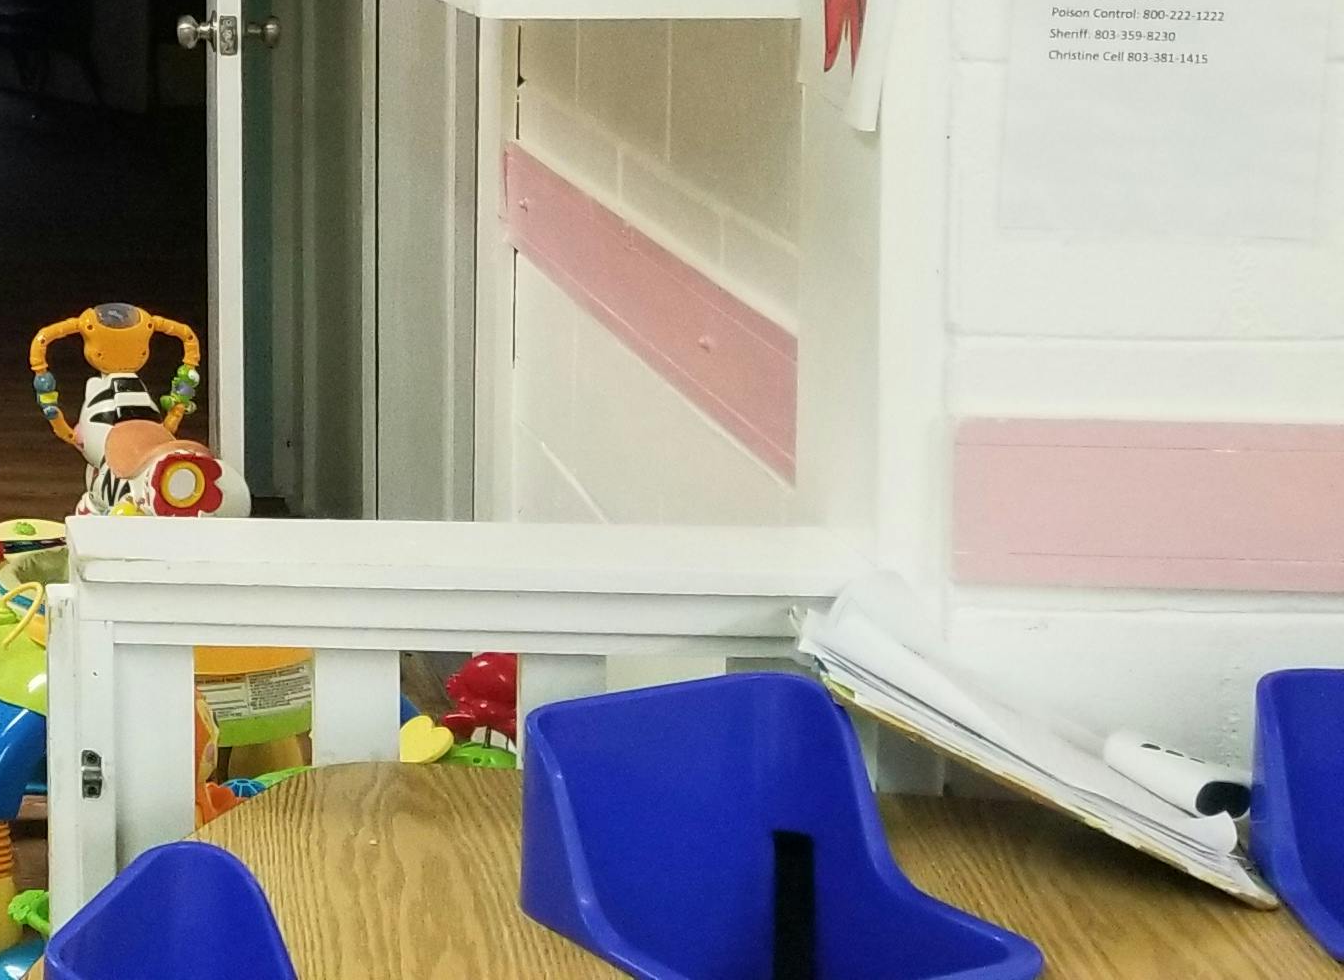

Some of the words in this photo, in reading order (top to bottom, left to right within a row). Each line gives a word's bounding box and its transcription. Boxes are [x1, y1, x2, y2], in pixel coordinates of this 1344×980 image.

[1051, 7, 1091, 18] Poison
[1093, 8, 1141, 20] Control:
[1142, 9, 1226, 22] 800-222-1222
[1094, 29, 1177, 42] 803-359-8230
[1048, 49, 1100, 62] Christine
[1103, 51, 1125, 62] Cell
[1126, 52, 1209, 65] 803-381-1415
